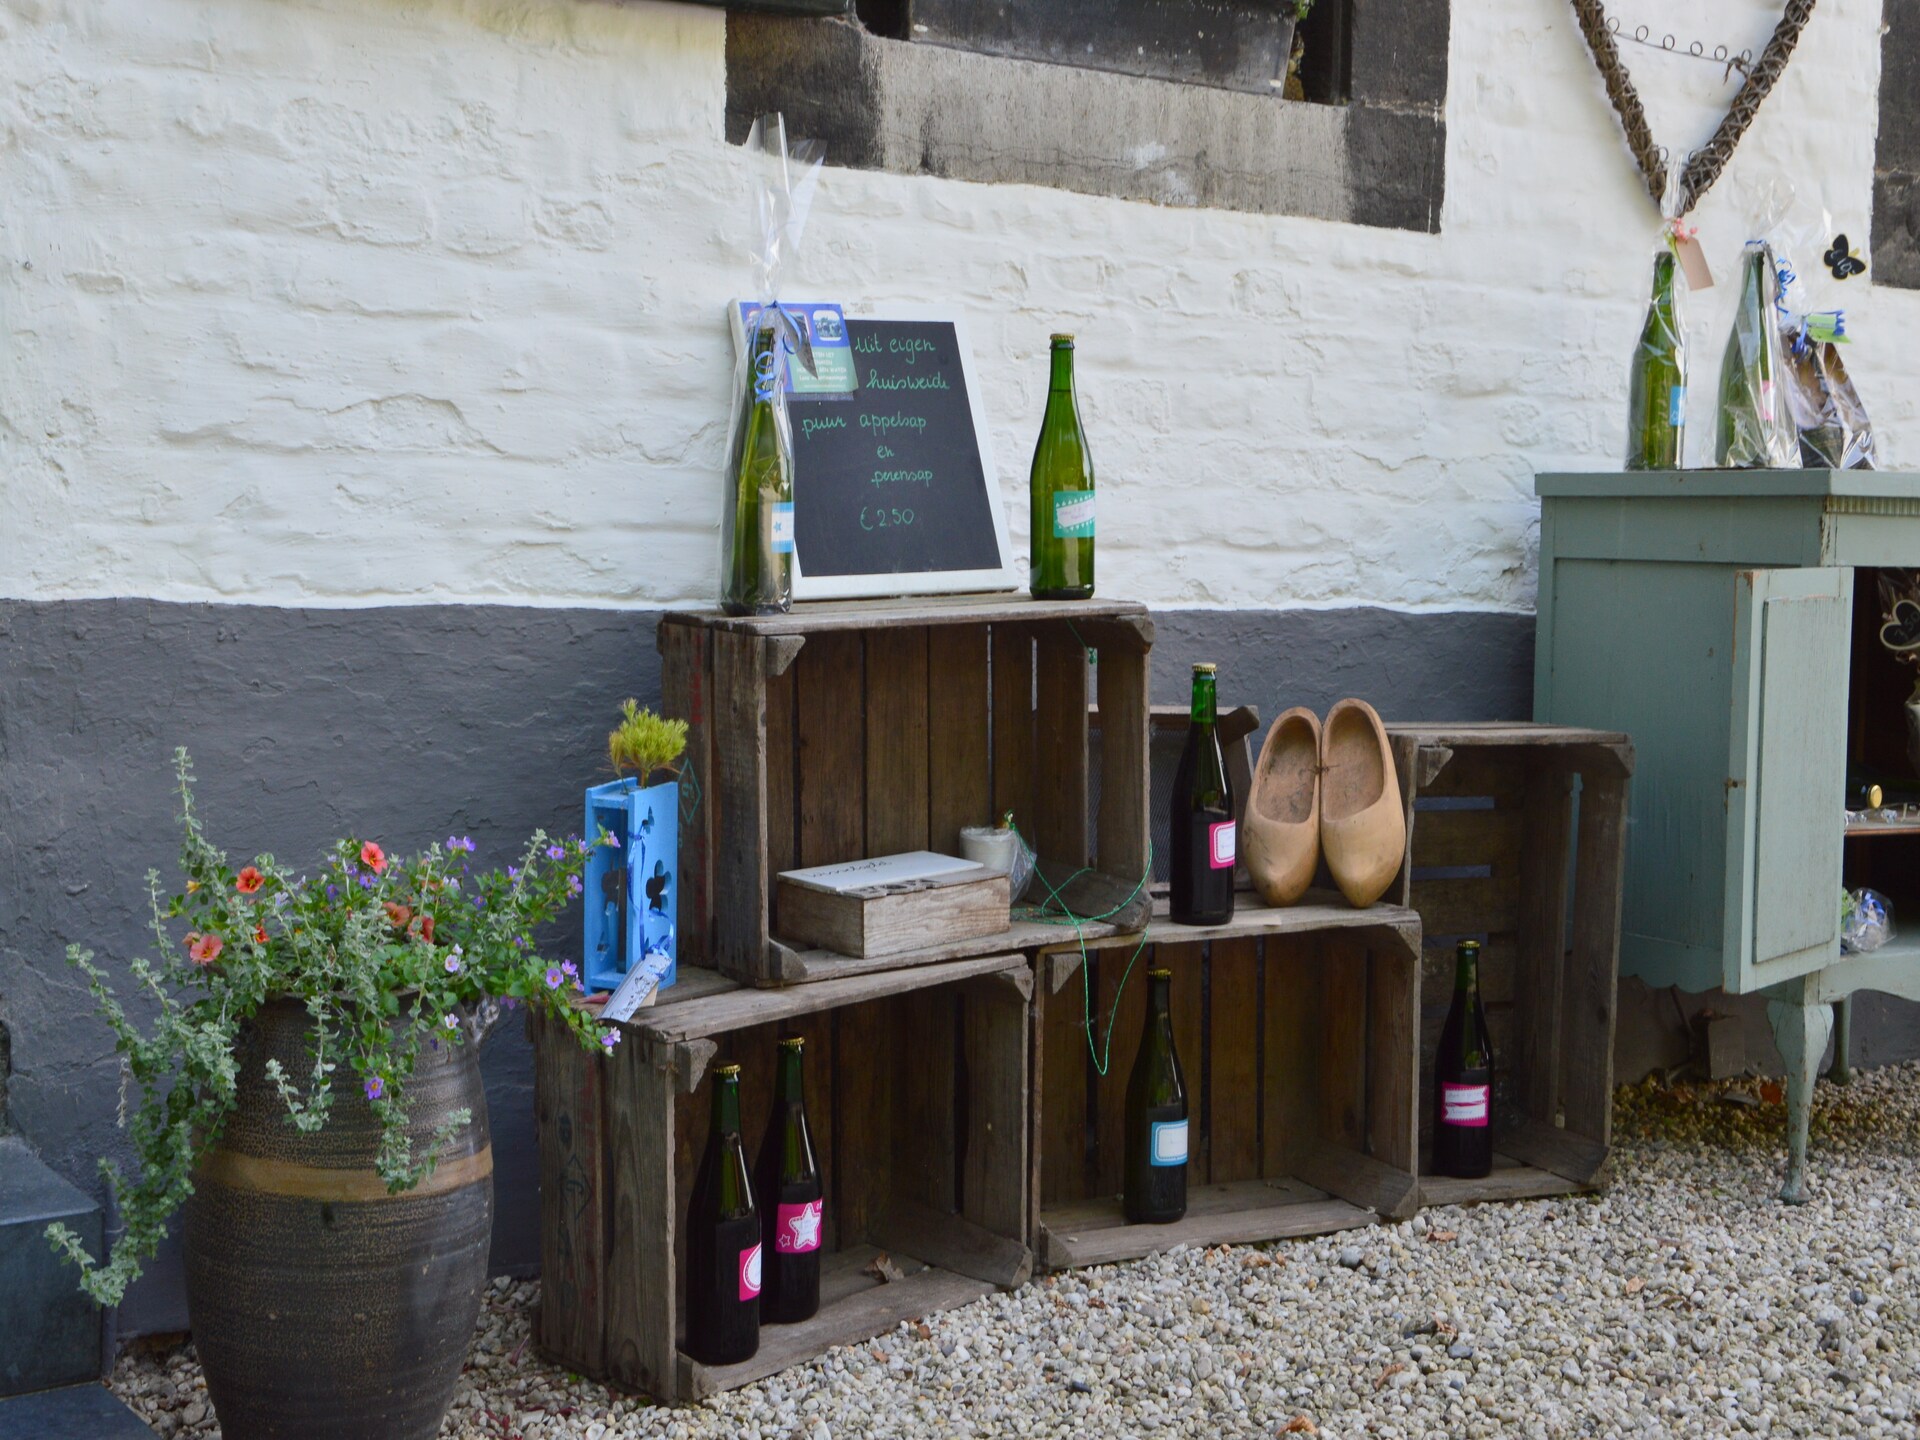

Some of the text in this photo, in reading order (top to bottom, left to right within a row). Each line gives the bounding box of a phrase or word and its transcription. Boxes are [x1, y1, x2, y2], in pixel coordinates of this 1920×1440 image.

[889, 337, 936, 364] eigen
[860, 410, 927, 437] appelsap
[877, 445, 895, 459] en
[871, 470, 933, 489] perensap
